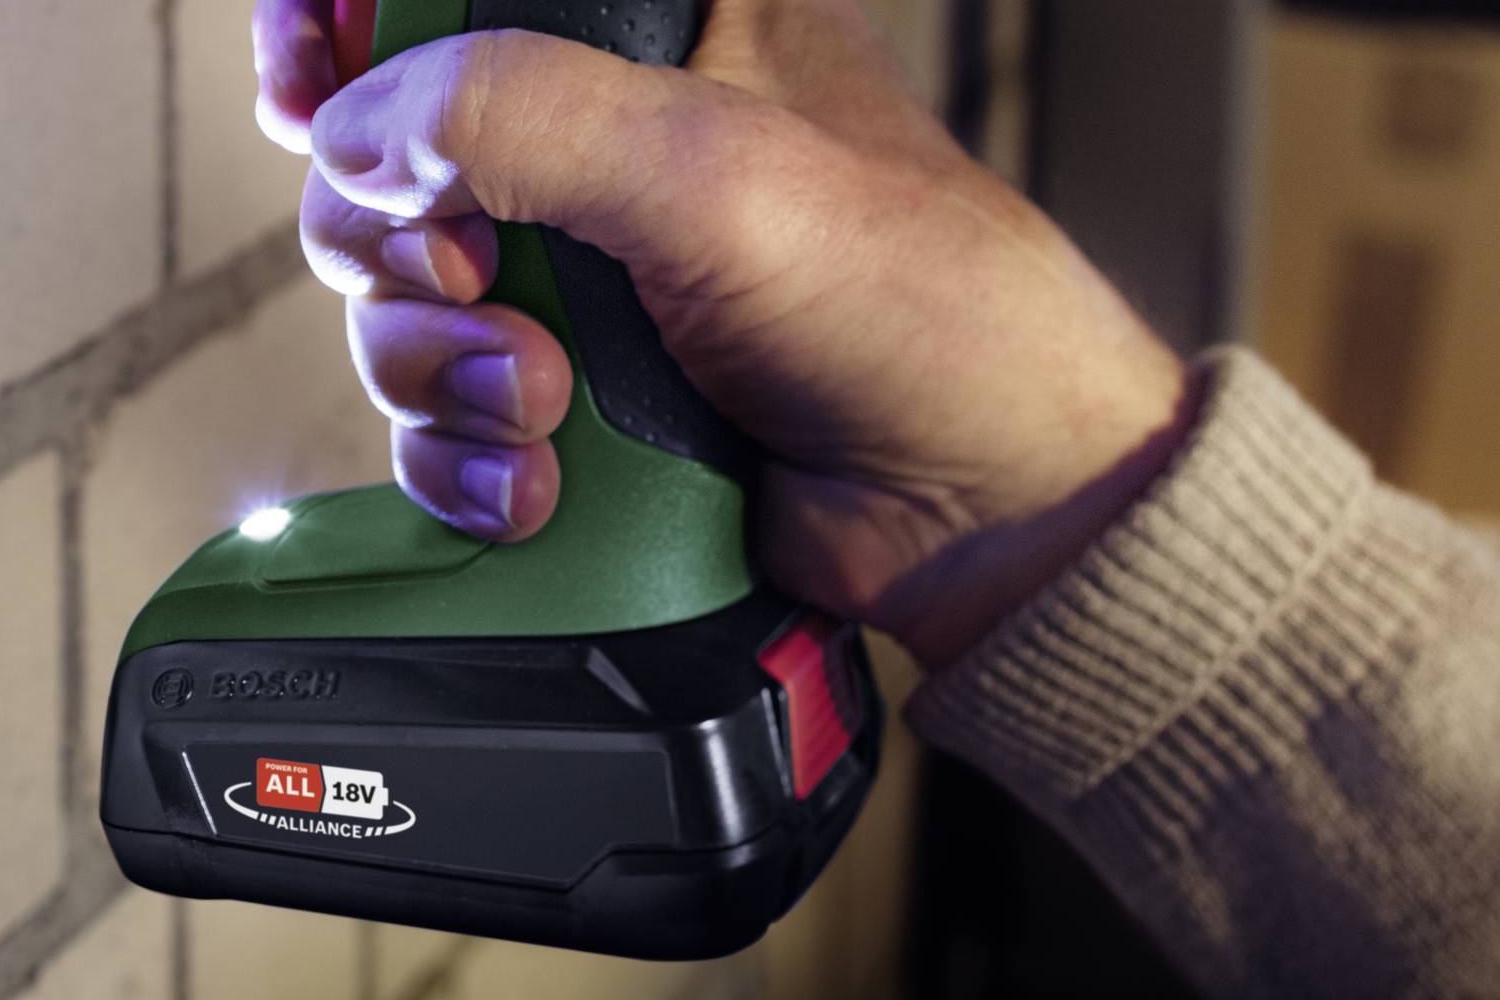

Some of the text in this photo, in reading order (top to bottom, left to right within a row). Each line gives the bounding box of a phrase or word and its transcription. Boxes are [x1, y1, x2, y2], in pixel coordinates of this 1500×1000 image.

[211, 669, 343, 700] BOSCH
[265, 762, 309, 775] POWER FOR
[265, 773, 377, 805] ALL 18V
[276, 815, 363, 840] ALLIANCE
